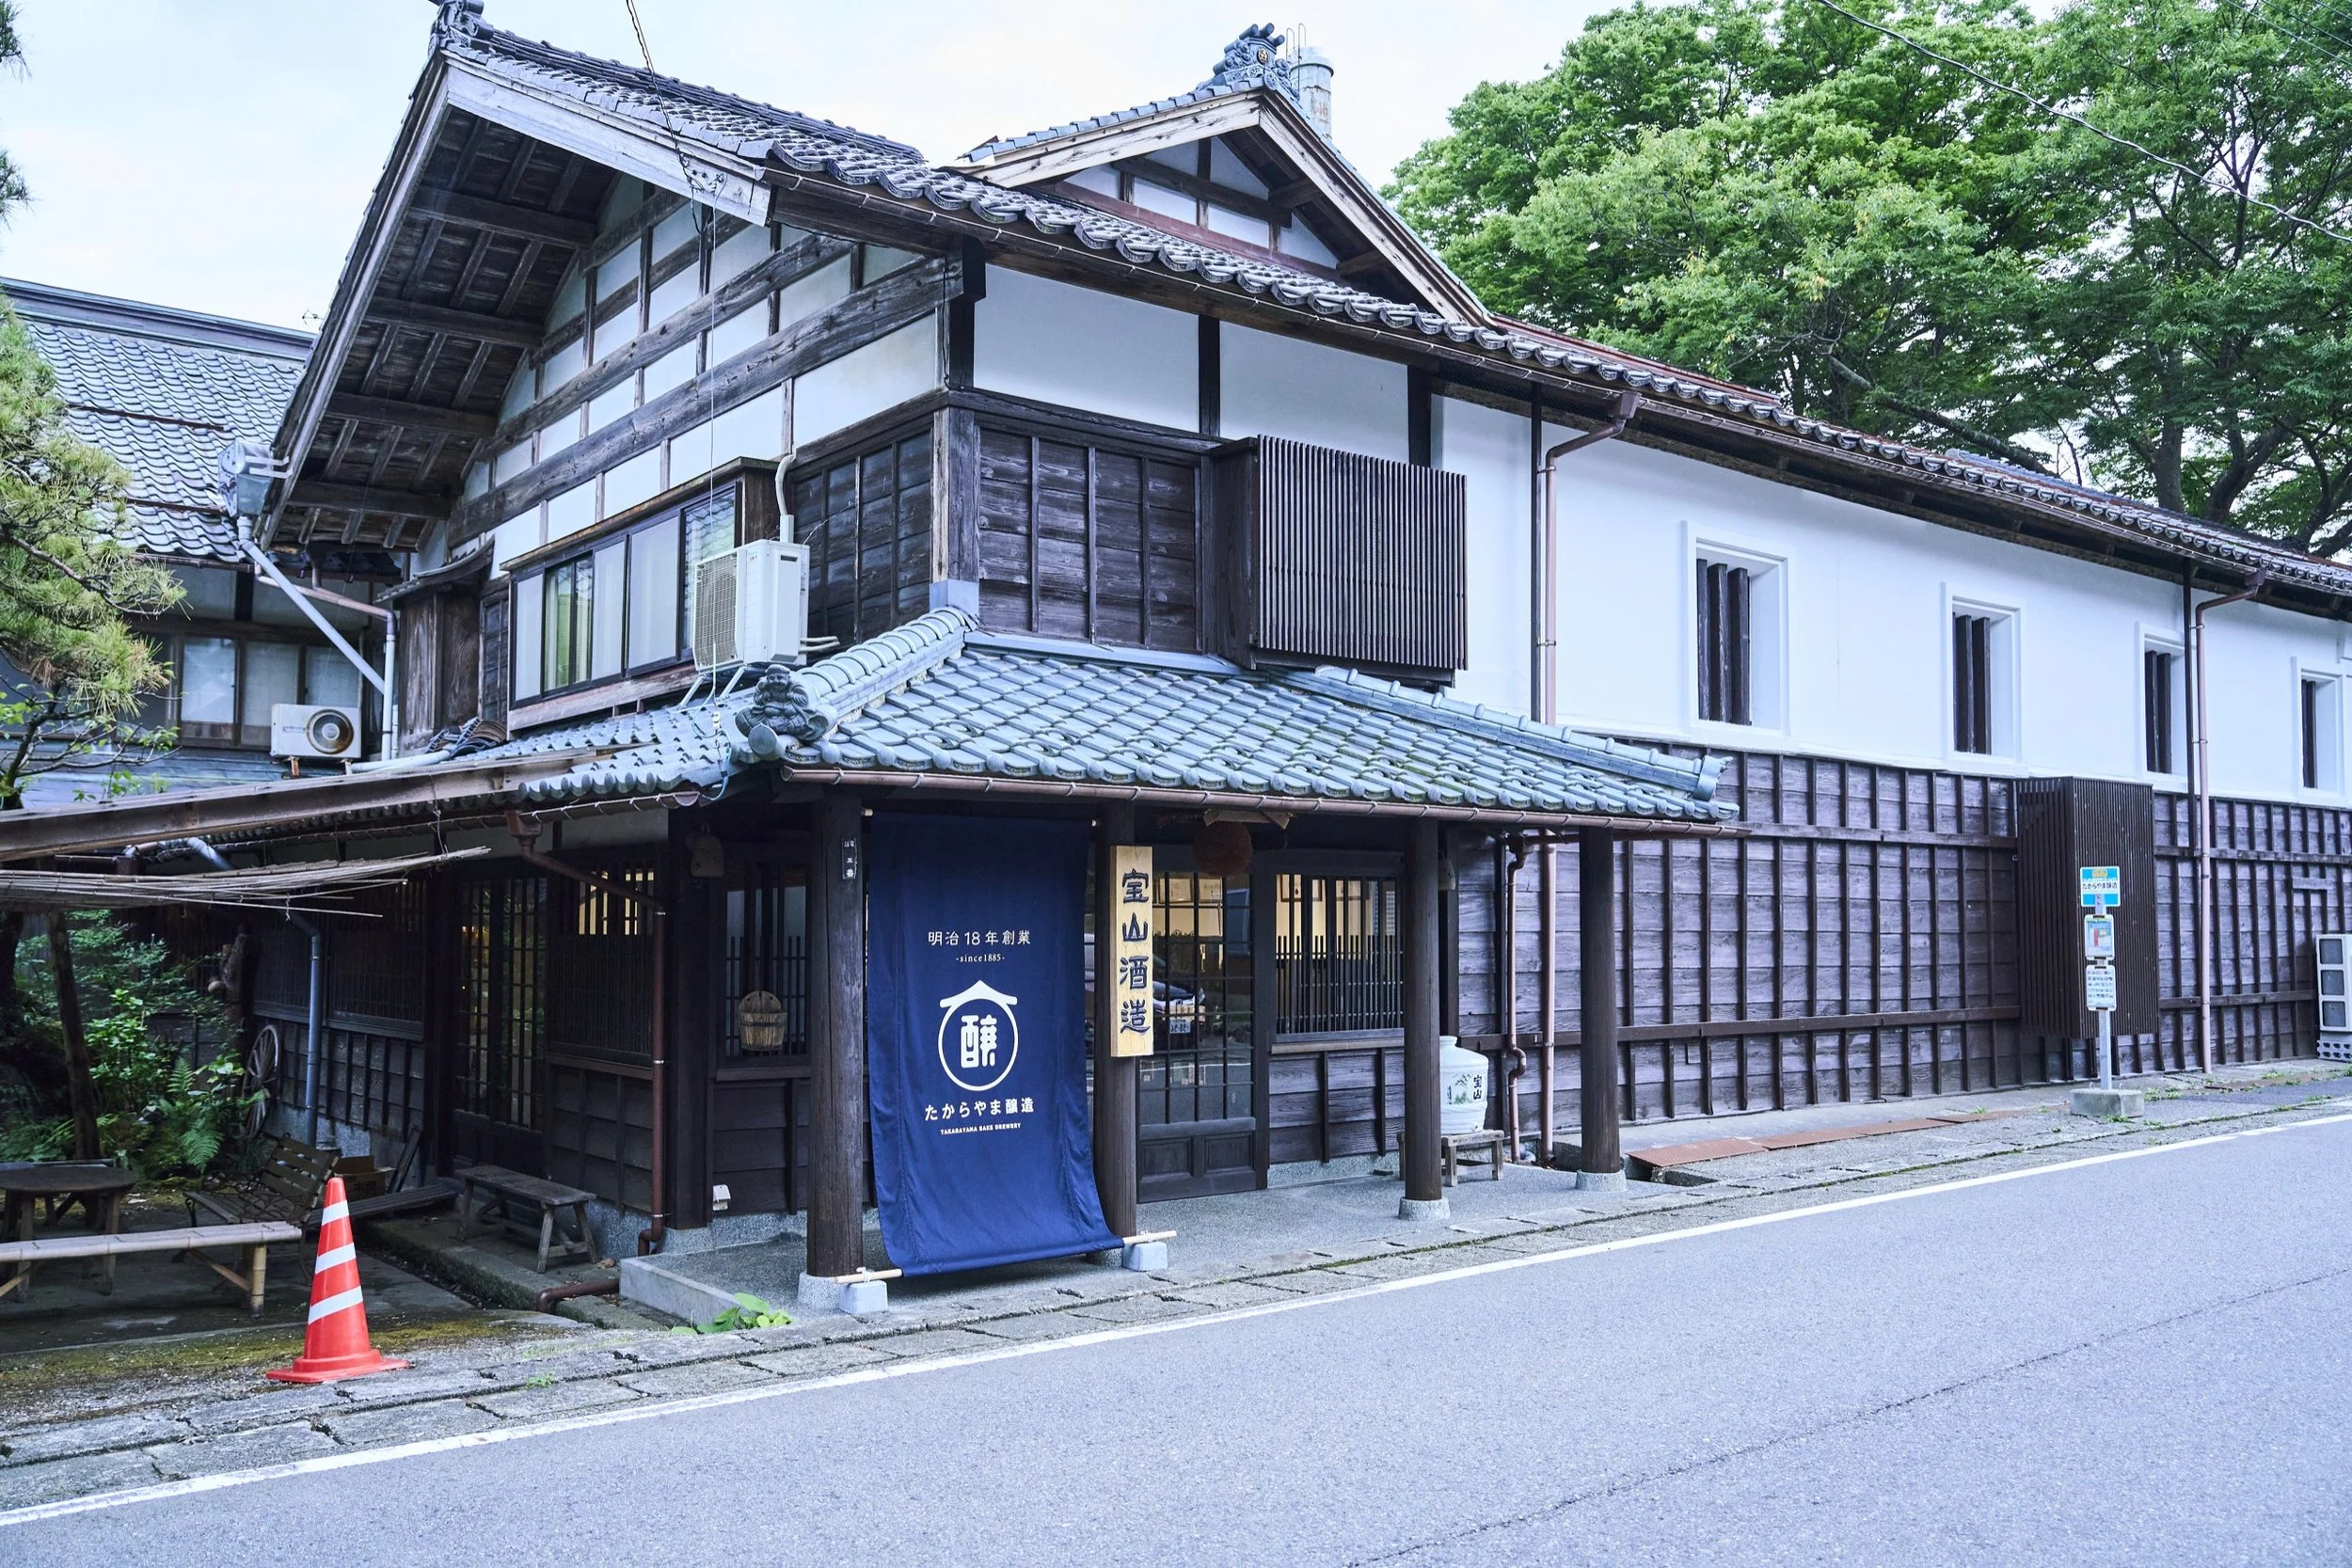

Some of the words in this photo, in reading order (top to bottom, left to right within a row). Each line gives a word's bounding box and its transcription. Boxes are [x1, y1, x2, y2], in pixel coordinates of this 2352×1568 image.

[1120, 867, 1151, 1036] 宝山酒造
[1472, 1074, 1483, 1101] 宝山
[924, 1097, 1035, 1121] たからやま醸造
